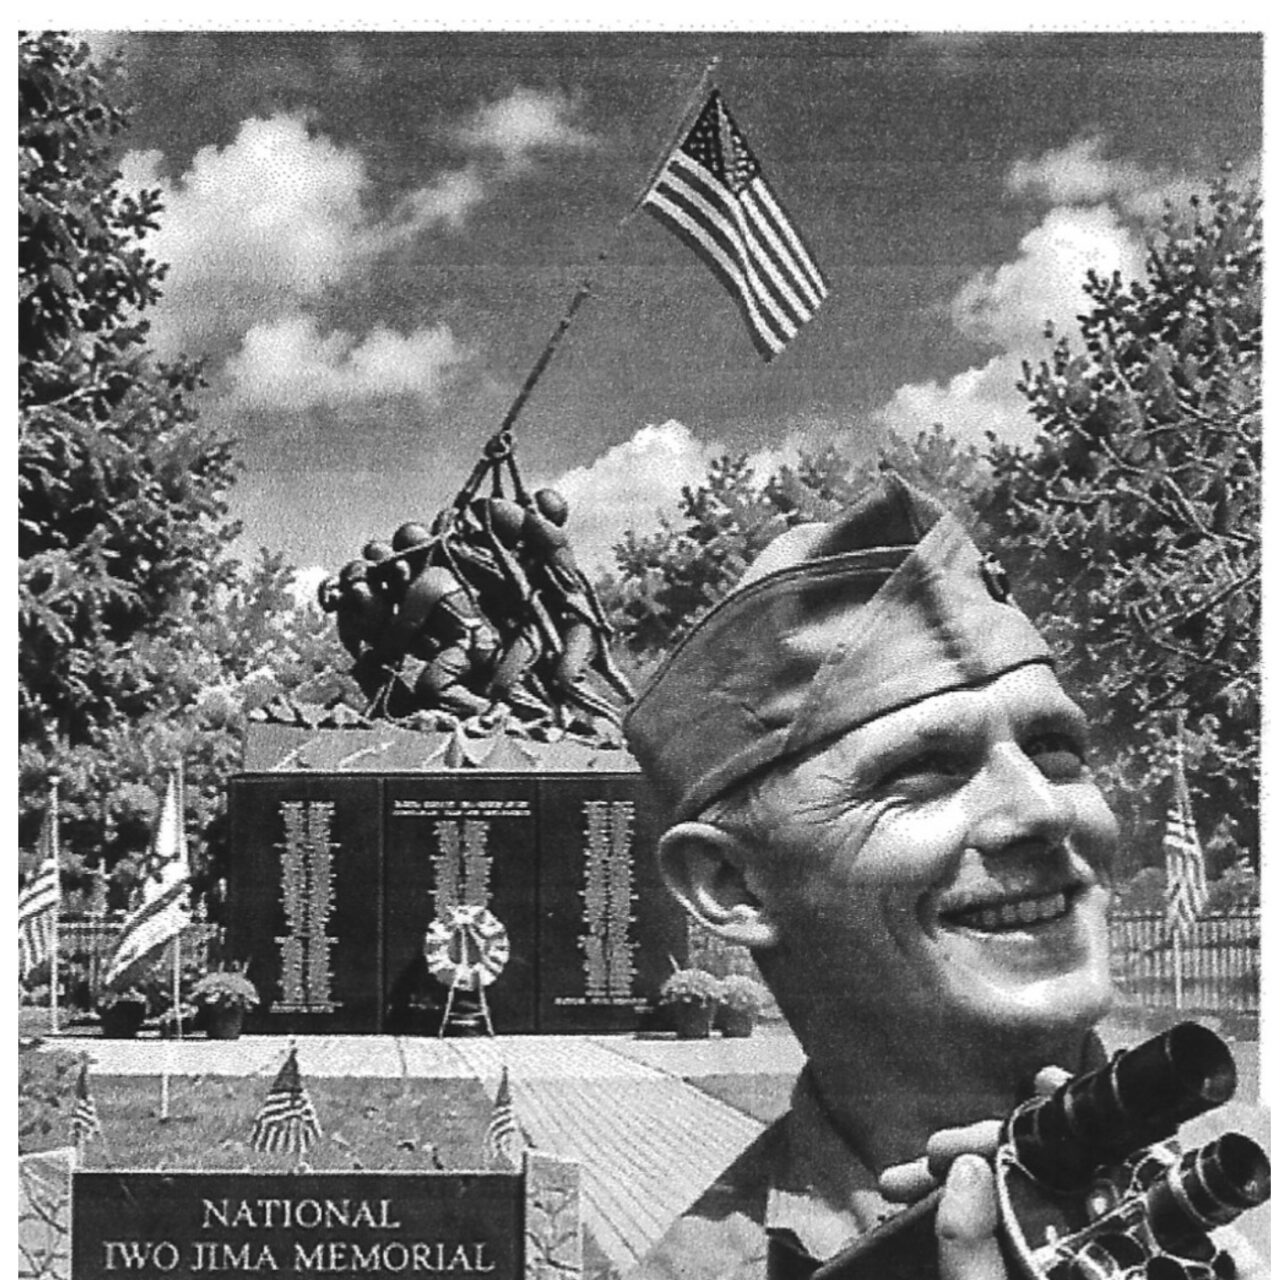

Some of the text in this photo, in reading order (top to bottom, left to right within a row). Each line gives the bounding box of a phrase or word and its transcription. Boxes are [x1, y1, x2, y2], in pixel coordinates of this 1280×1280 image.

[202, 1199, 401, 1229] NATIONAL
[104, 1242, 496, 1271] IWO JIMA MEMORIAL
